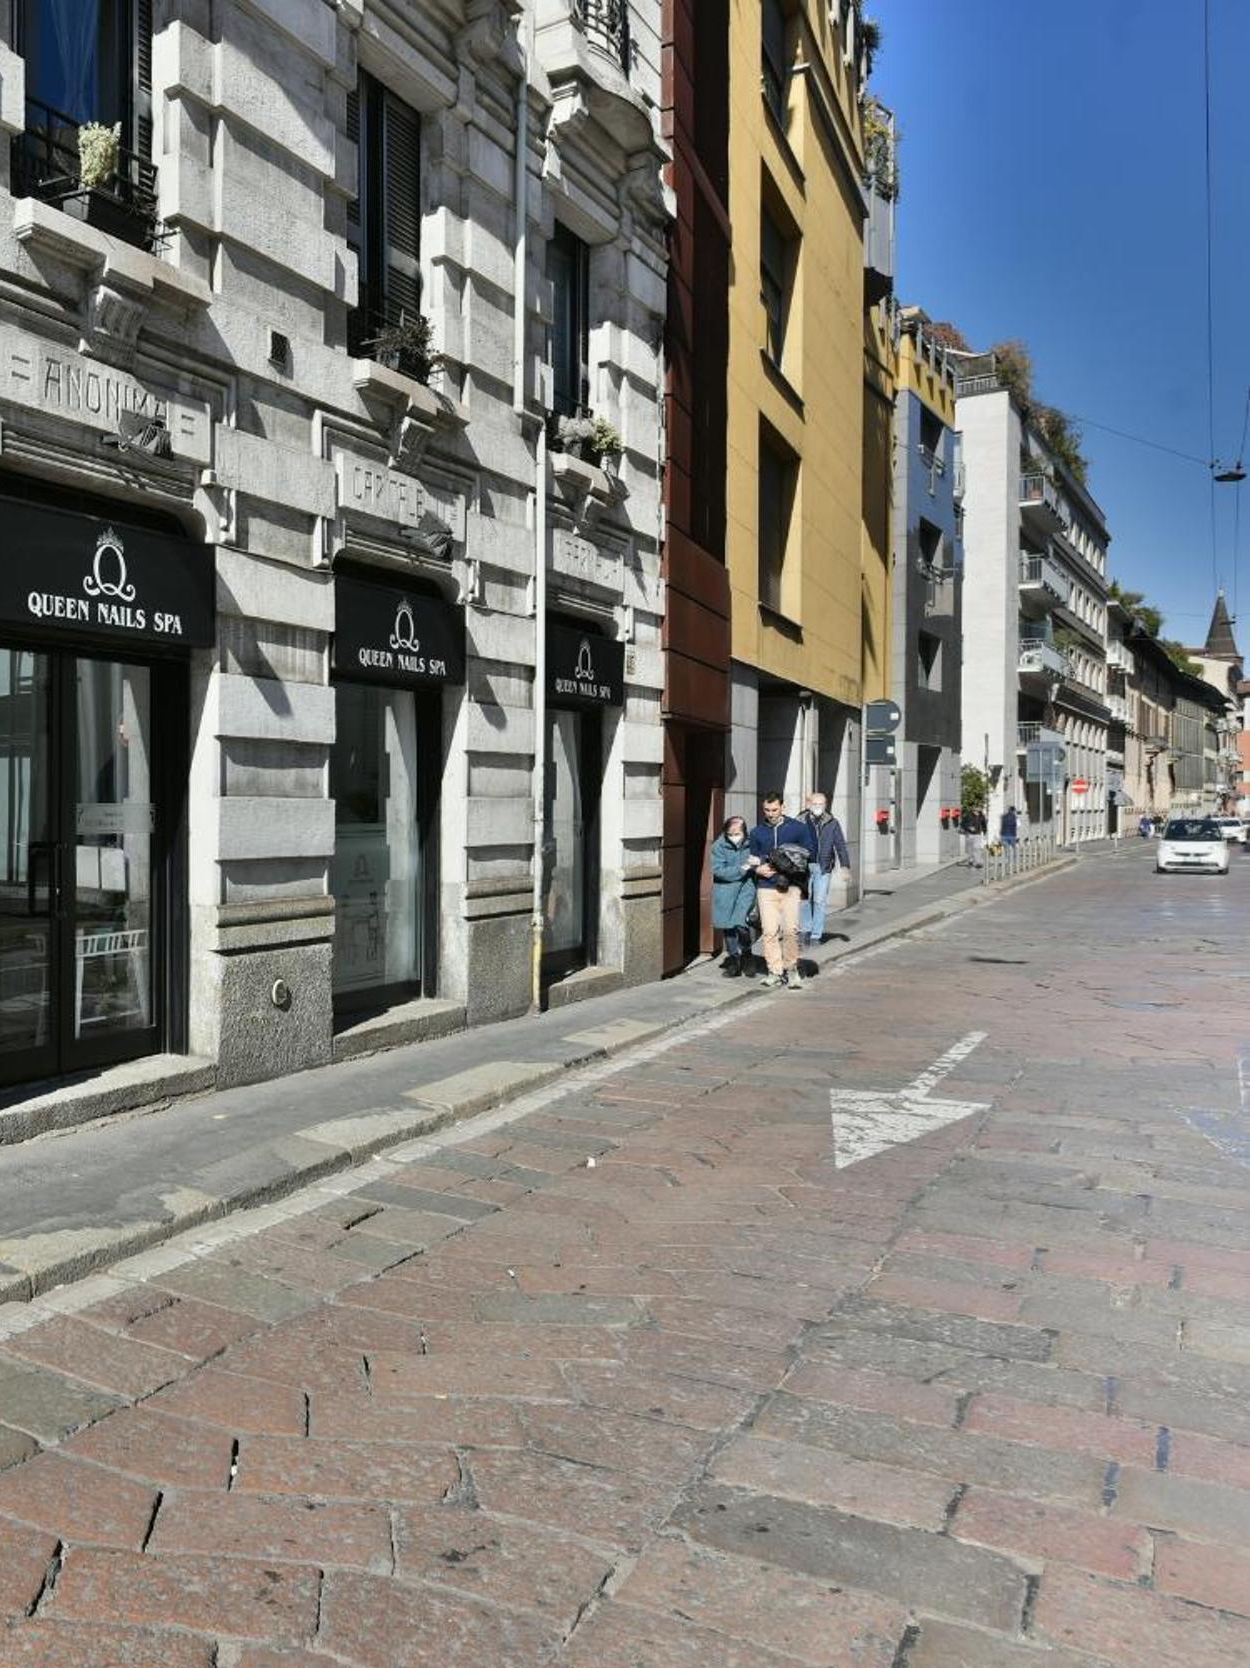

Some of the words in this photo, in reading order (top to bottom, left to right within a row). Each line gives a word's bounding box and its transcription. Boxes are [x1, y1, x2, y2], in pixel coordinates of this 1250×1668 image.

[28, 591, 89, 621] QUEEN
[98, 603, 146, 629] NAILS
[153, 612, 183, 635] SPA
[359, 648, 392, 668] QUEEN
[398, 654, 426, 673] NAILS
[430, 659, 446, 676] SPA
